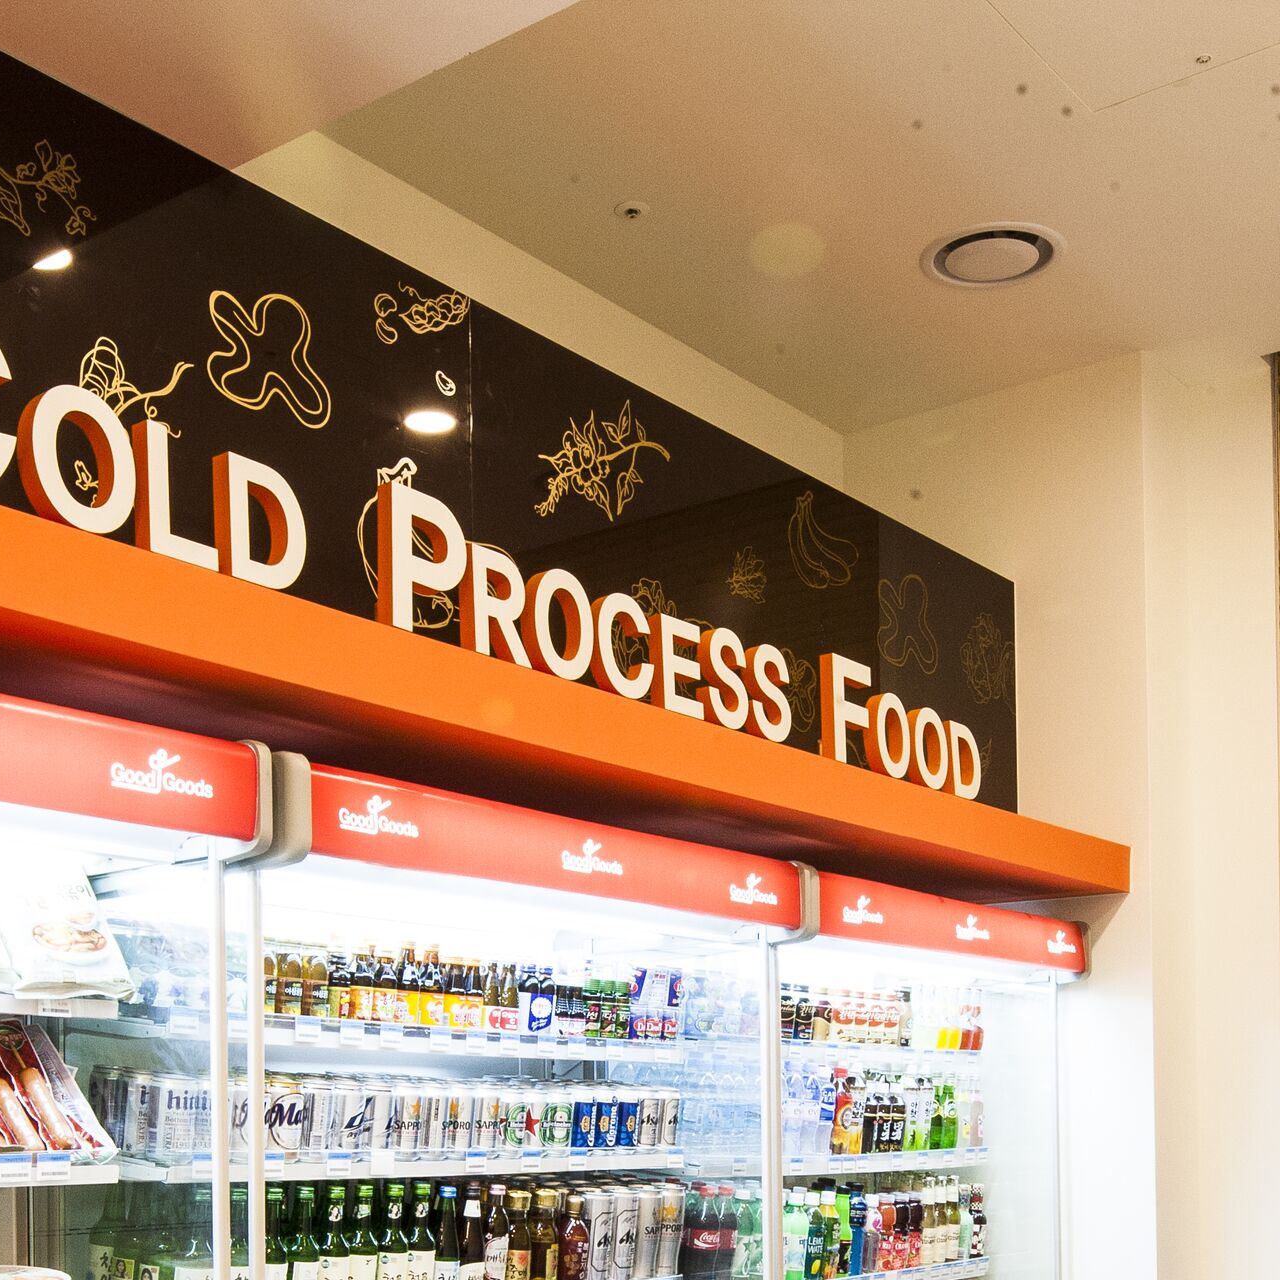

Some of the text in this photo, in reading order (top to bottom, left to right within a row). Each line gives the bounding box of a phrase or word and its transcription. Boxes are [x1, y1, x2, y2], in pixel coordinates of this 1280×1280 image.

[376, 480, 792, 744] PROCESS
[820, 652, 983, 800] FOOD
[110, 762, 214, 799] Good Goods
[338, 807, 419, 838] Good Goods
[561, 850, 623, 876] Good Goods
